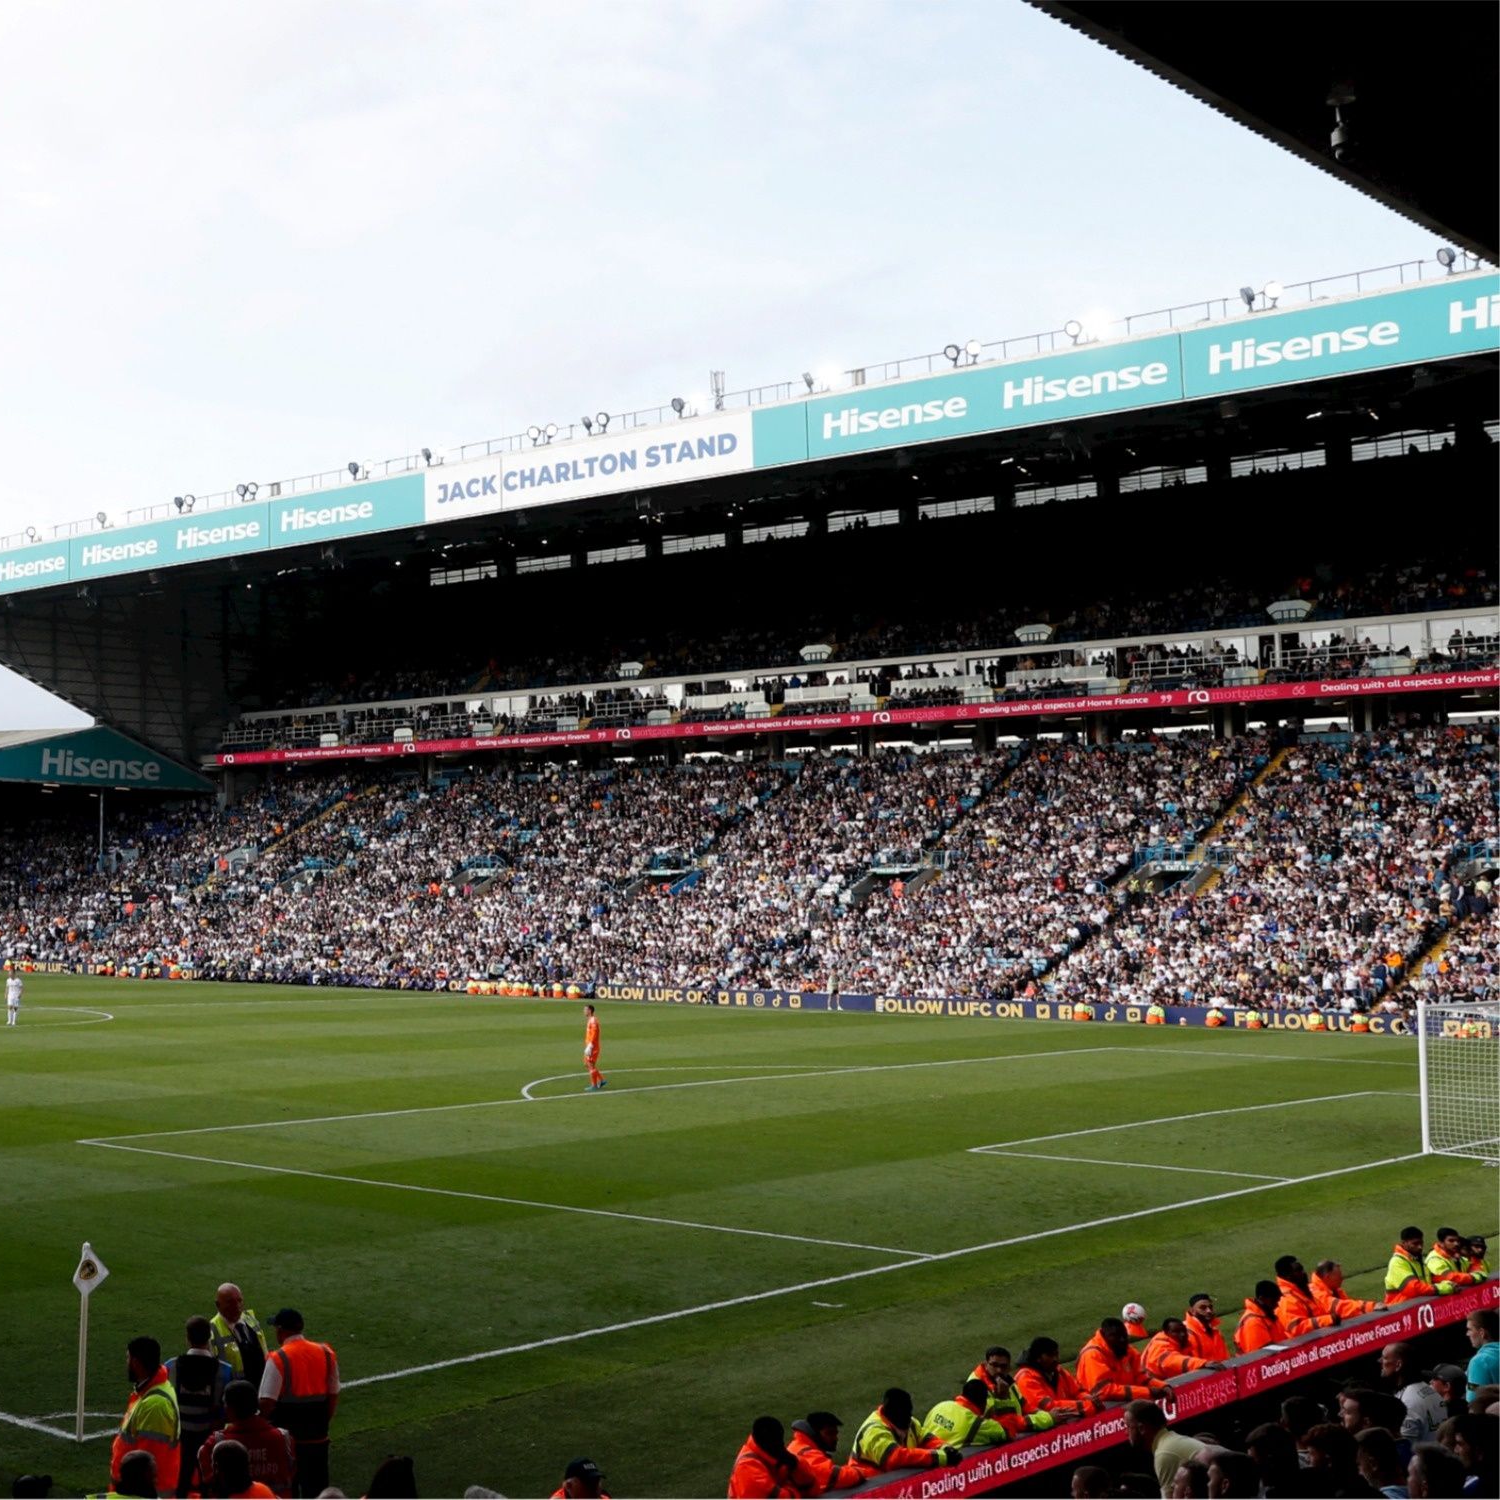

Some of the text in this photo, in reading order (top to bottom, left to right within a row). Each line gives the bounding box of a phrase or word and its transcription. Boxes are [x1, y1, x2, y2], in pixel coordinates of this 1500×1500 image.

[1209, 320, 1399, 375] Hisense
[1003, 362, 1168, 410] Hisense
[823, 396, 968, 440] Hisense
[437, 432, 738, 504] JACK CHARLTON STAND
[281, 501, 374, 532] Hisense
[176, 521, 260, 550] Hisense
[82, 537, 158, 567] Hisense
[1212, 687, 1278, 700] mortgages
[1321, 683, 1360, 692] Dealing
[1362, 681, 1385, 689] with
[1387, 680, 1401, 688] all
[1403, 678, 1443, 688] aspects
[1445, 676, 1456, 684] of
[1458, 675, 1491, 683] Home
[892, 709, 946, 722] mortgages
[979, 706, 1010, 714] Dealing
[1011, 704, 1031, 712] with
[1044, 701, 1076, 711] aspects
[1077, 700, 1086, 708] of
[1114, 697, 1149, 705] Finance
[41, 748, 161, 781] Hisense
[597, 985, 645, 1000] OLLOW
[647, 988, 683, 1002] LUFC
[948, 1000, 992, 1017] LUFC
[995, 1002, 1024, 1018] ON
[1327, 1014, 1385, 1034] LUC
[1261, 1321, 1401, 1379] Dealing with all aspects of Home Finance
[1176, 1375, 1237, 1413] mortgages
[933, 1413, 955, 1432] SENIOR
[249, 1461, 279, 1477] EWARD
[922, 1417, 1127, 1499] Dealing with all aspects of Home Financ
